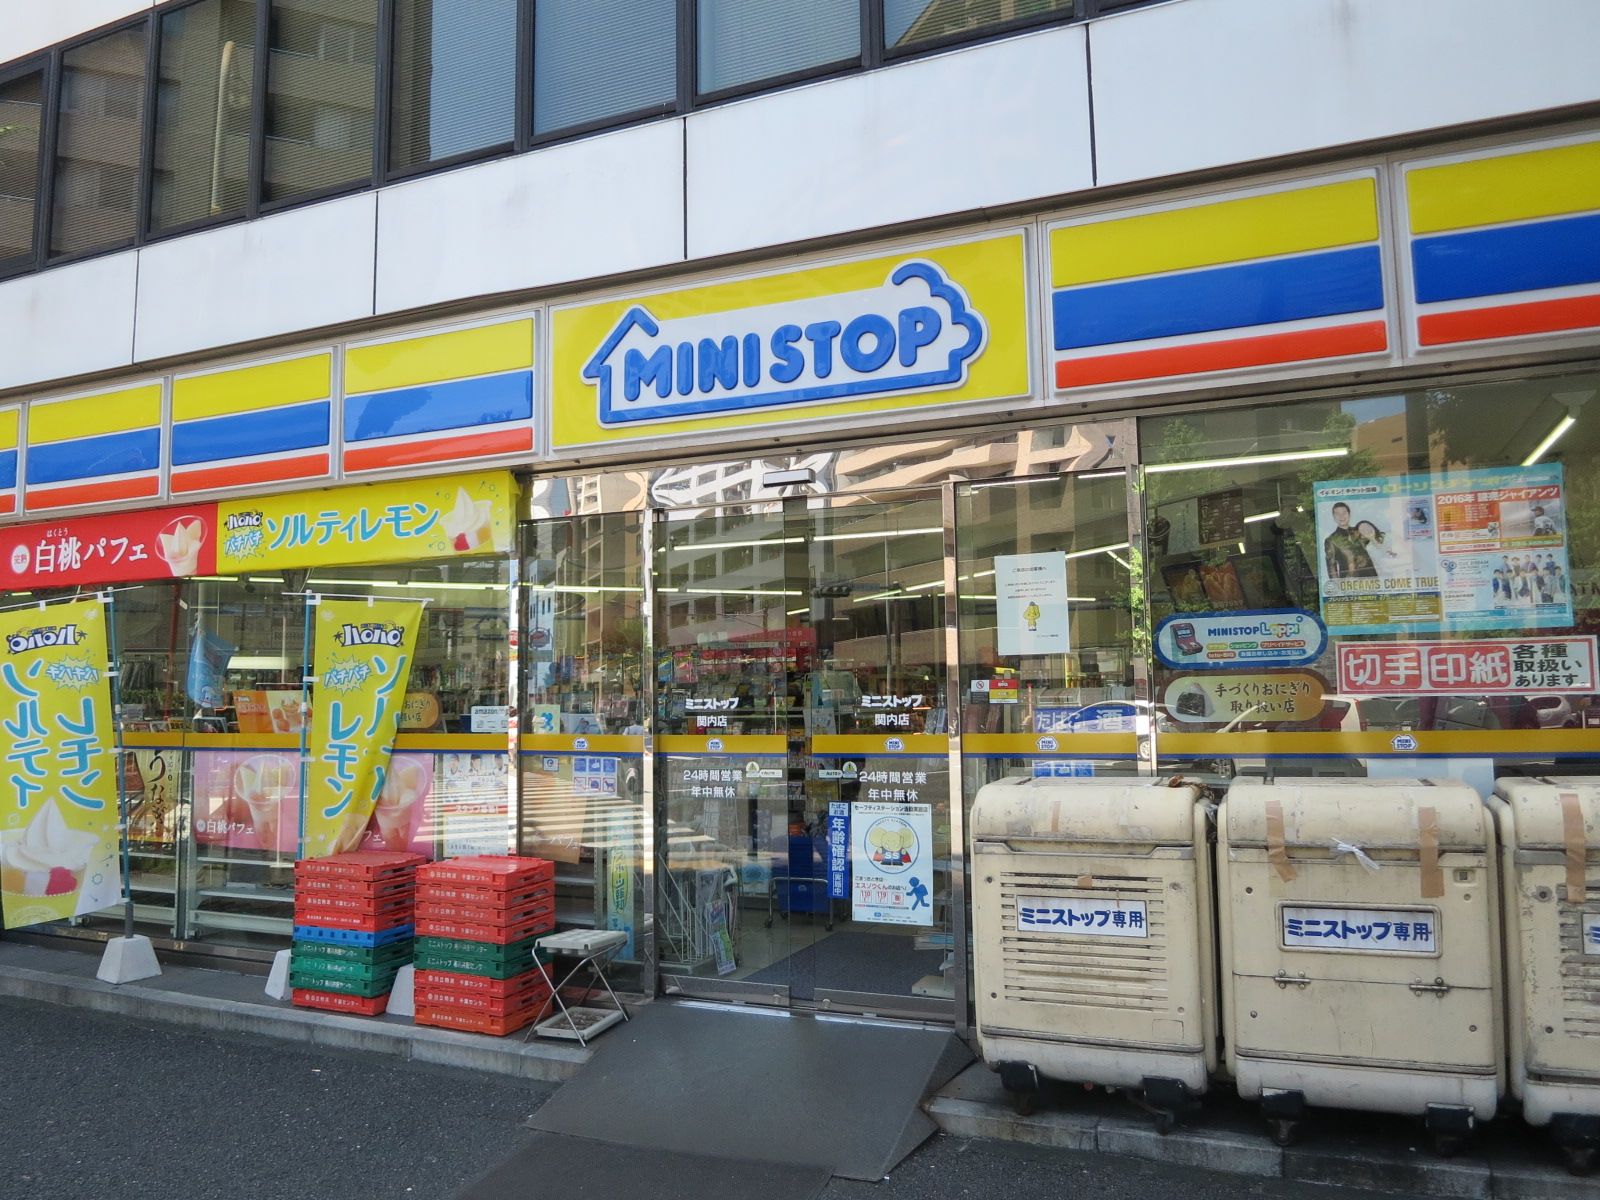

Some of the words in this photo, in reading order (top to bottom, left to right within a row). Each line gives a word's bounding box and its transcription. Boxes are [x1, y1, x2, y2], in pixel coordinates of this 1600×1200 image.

[624, 305, 942, 402] MINISTOP
[266, 502, 440, 551] ソルティレモン
[35, 536, 148, 574] 白桃パフェ
[1340, 579, 1381, 592] DREAMS
[1384, 577, 1412, 590] COME
[1415, 576, 1440, 588] TRUE
[1207, 626, 1259, 637] MINISTOP
[1513, 643, 1569, 659] 各種
[1346, 652, 1420, 687] 切手
[1429, 650, 1508, 684] 印紙
[1513, 659, 1582, 673] 取扱い
[323, 663, 372, 687] パチパチ
[1515, 673, 1579, 687] あります
[1215, 682, 1311, 697] 手づくりおにぎり
[685, 697, 739, 710] ミニストップ
[861, 694, 923, 707] ミニストップ
[1231, 699, 1296, 713] 取り扱い店
[696, 715, 727, 727] 関内店
[874, 713, 910, 726] 関内店
[1036, 709, 1081, 732] たばこ
[1096, 708, 1123, 731] 酒
[323, 701, 363, 819] レモン
[683, 769, 743, 781] 24時間営業
[859, 771, 927, 784] 24時間営業
[691, 786, 736, 798] 年中無休
[868, 788, 919, 802] 年中無休
[207, 820, 255, 834] 白桃パフェ
[831, 817, 846, 872] 年齢確認
[1021, 907, 1144, 930] ミニストップ専用
[1287, 917, 1433, 943] ミニストップ専用
